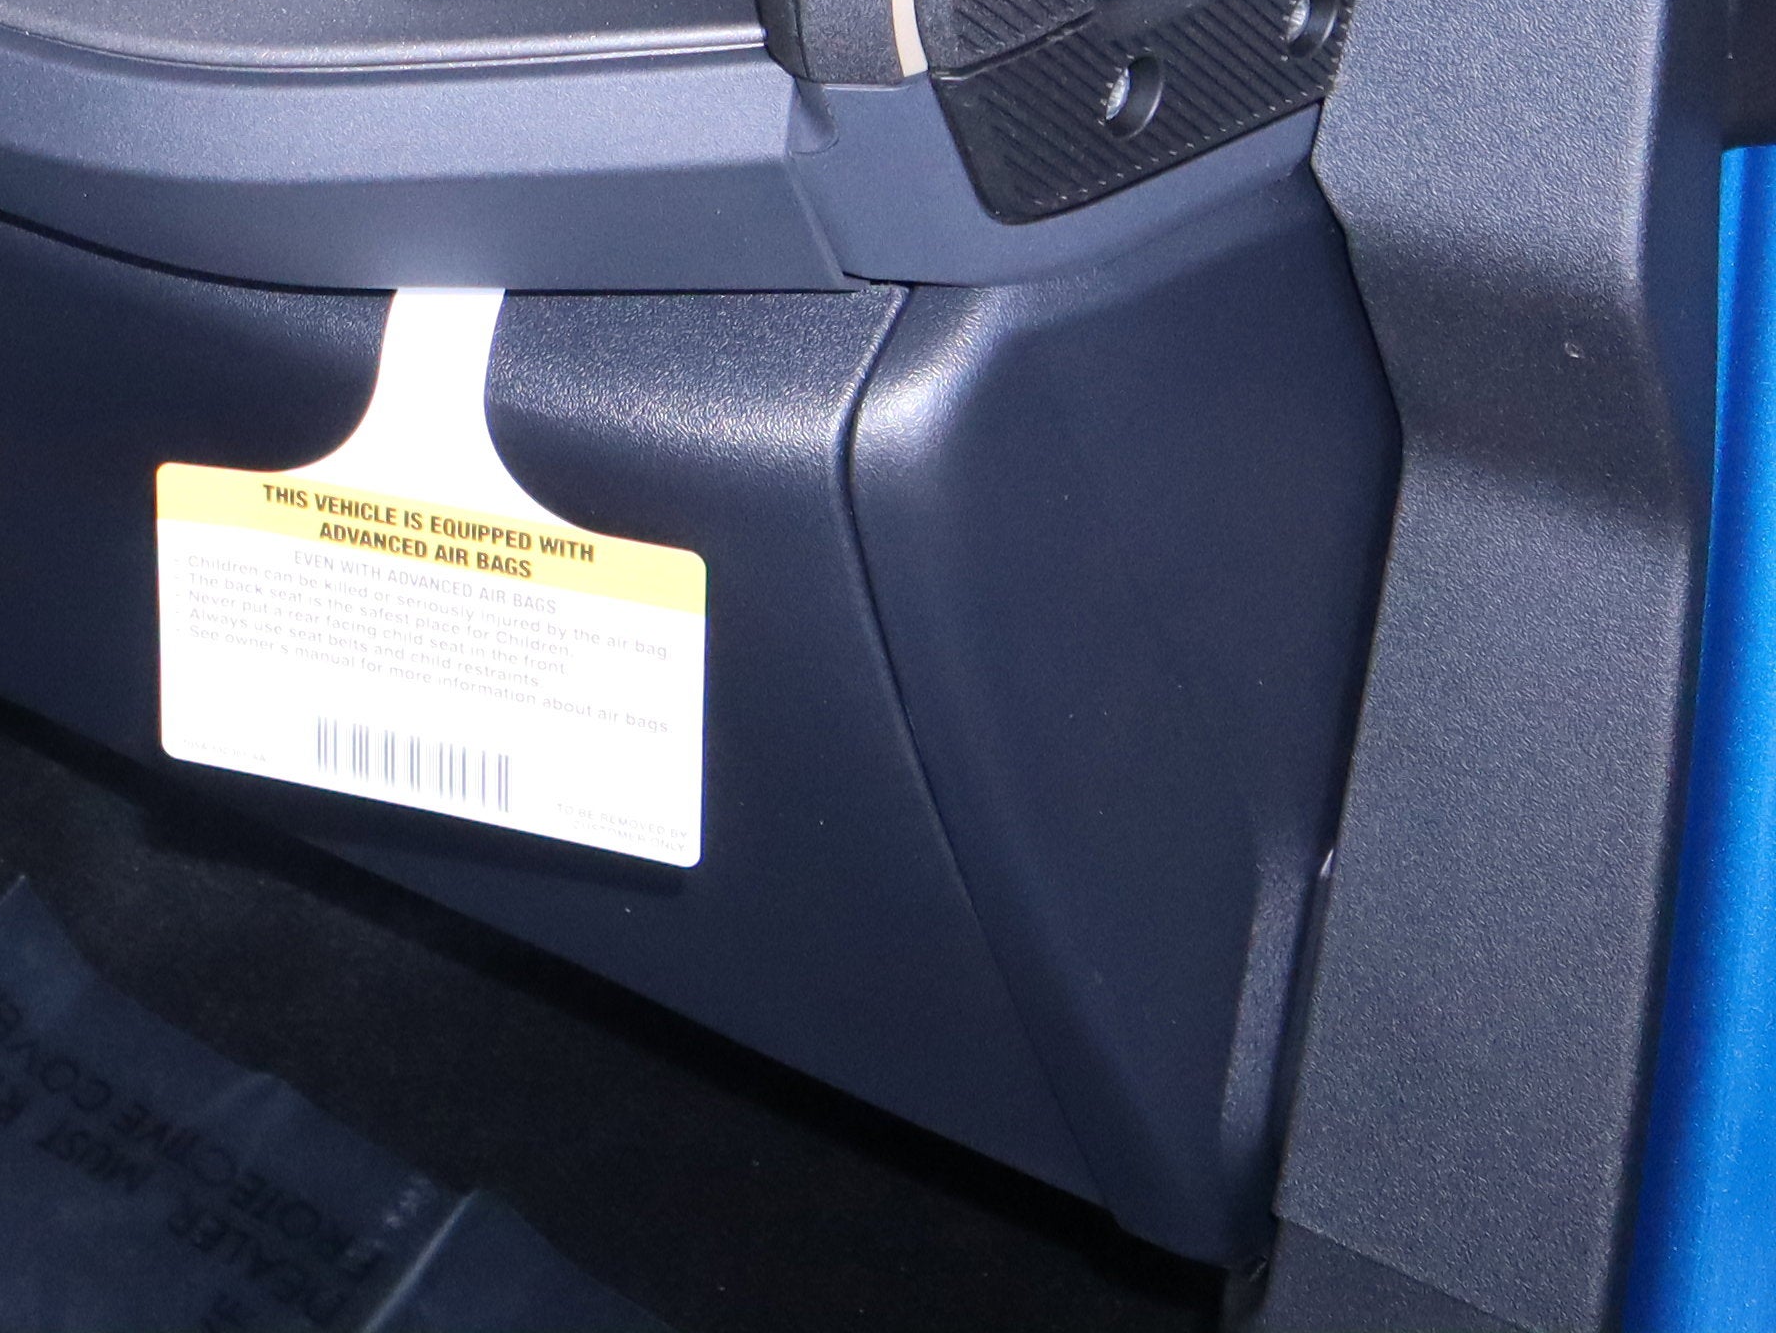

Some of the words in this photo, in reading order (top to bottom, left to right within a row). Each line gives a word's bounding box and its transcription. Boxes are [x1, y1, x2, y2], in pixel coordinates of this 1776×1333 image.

[263, 483, 309, 510] THIS
[314, 493, 398, 527] VEHICLE
[404, 510, 423, 531] IS
[430, 515, 533, 552] EQUIPPED
[538, 535, 595, 563] WITH
[319, 521, 428, 559] ADVANCED
[433, 542, 469, 567] AIR
[475, 550, 532, 580] BAGS
[187, 555, 259, 576] Children
[264, 568, 293, 583] can
[298, 573, 318, 589] be
[324, 578, 369, 598] killed
[374, 590, 390, 603] or
[397, 595, 475, 622] seriously
[481, 610, 540, 633] injured
[546, 621, 567, 640] by
[573, 628, 600, 645] the
[607, 635, 629, 651] air
[189, 572, 219, 588] The
[224, 578, 263, 595] back
[269, 587, 302, 604] seat
[308, 595, 323, 607] is
[327, 597, 353, 613] the
[359, 603, 410, 625] safest
[415, 616, 460, 635] place
[466, 624, 491, 640] for
[294, 550, 334, 571] EVEN
[340, 560, 381, 581] WITH
[387, 569, 473, 598] ADVANCED
[479, 586, 507, 605] AIR
[512, 593, 557, 614] BAGS
[188, 589, 237, 609] Never
[242, 599, 268, 614] put
[273, 607, 283, 617] a
[288, 609, 320, 624] rear
[326, 614, 377, 639] facing
[383, 627, 424, 646] child
[430, 636, 465, 655] seat
[470, 643, 485, 658] in
[491, 647, 518, 665] the
[189, 608, 248, 629] Always
[254, 621, 283, 635] use
[288, 627, 323, 644] seat
[328, 633, 369, 653] belts
[374, 644, 405, 661] and
[410, 649, 451, 670] child
[189, 624, 220, 641] See
[294, 646, 355, 668] manual
[360, 658, 384, 674] for
[389, 665, 432, 684] more
[438, 675, 537, 706] information
[542, 696, 592, 718] about
[597, 708, 619, 723] air
